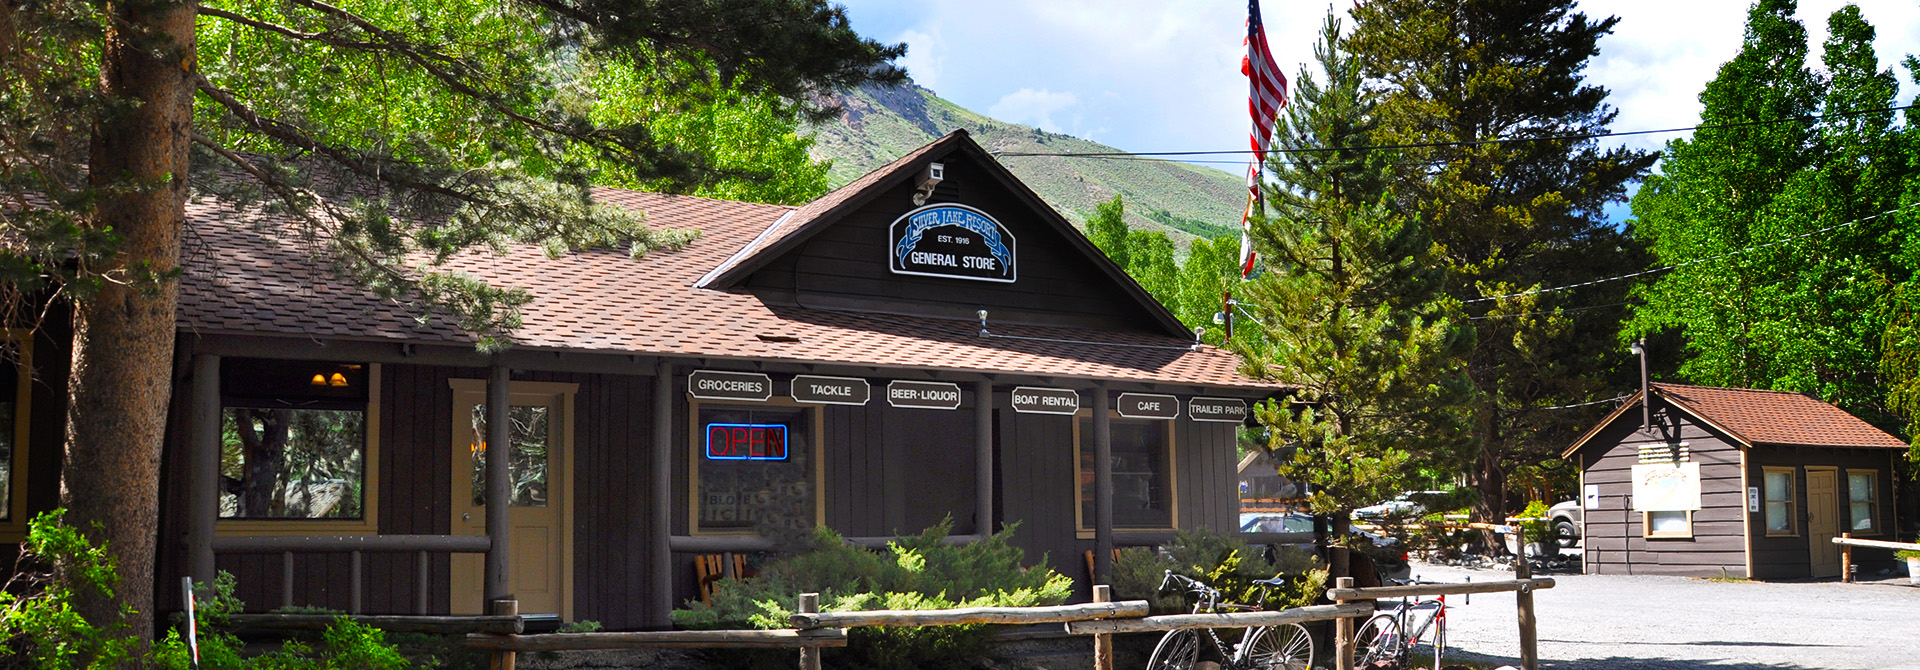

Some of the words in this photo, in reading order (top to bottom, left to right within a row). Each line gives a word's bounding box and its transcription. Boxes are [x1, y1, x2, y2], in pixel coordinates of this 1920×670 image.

[912, 211, 941, 236] SILVER
[941, 210, 966, 227] LAKE
[966, 212, 996, 241] RESORT
[937, 235, 954, 244] EST.
[955, 237, 970, 245] 1916
[911, 251, 958, 267] GENERAL
[962, 255, 996, 270] STORE
[698, 379, 763, 393] GROCERIES
[810, 384, 851, 396] TACKLE
[1014, 394, 1039, 405] BOAT
[1042, 396, 1077, 407] RENTAL
[1137, 401, 1160, 411] CAFE
[1190, 404, 1223, 415] TRAILER
[1224, 405, 1246, 416] PARK
[709, 426, 784, 456] OPEN
